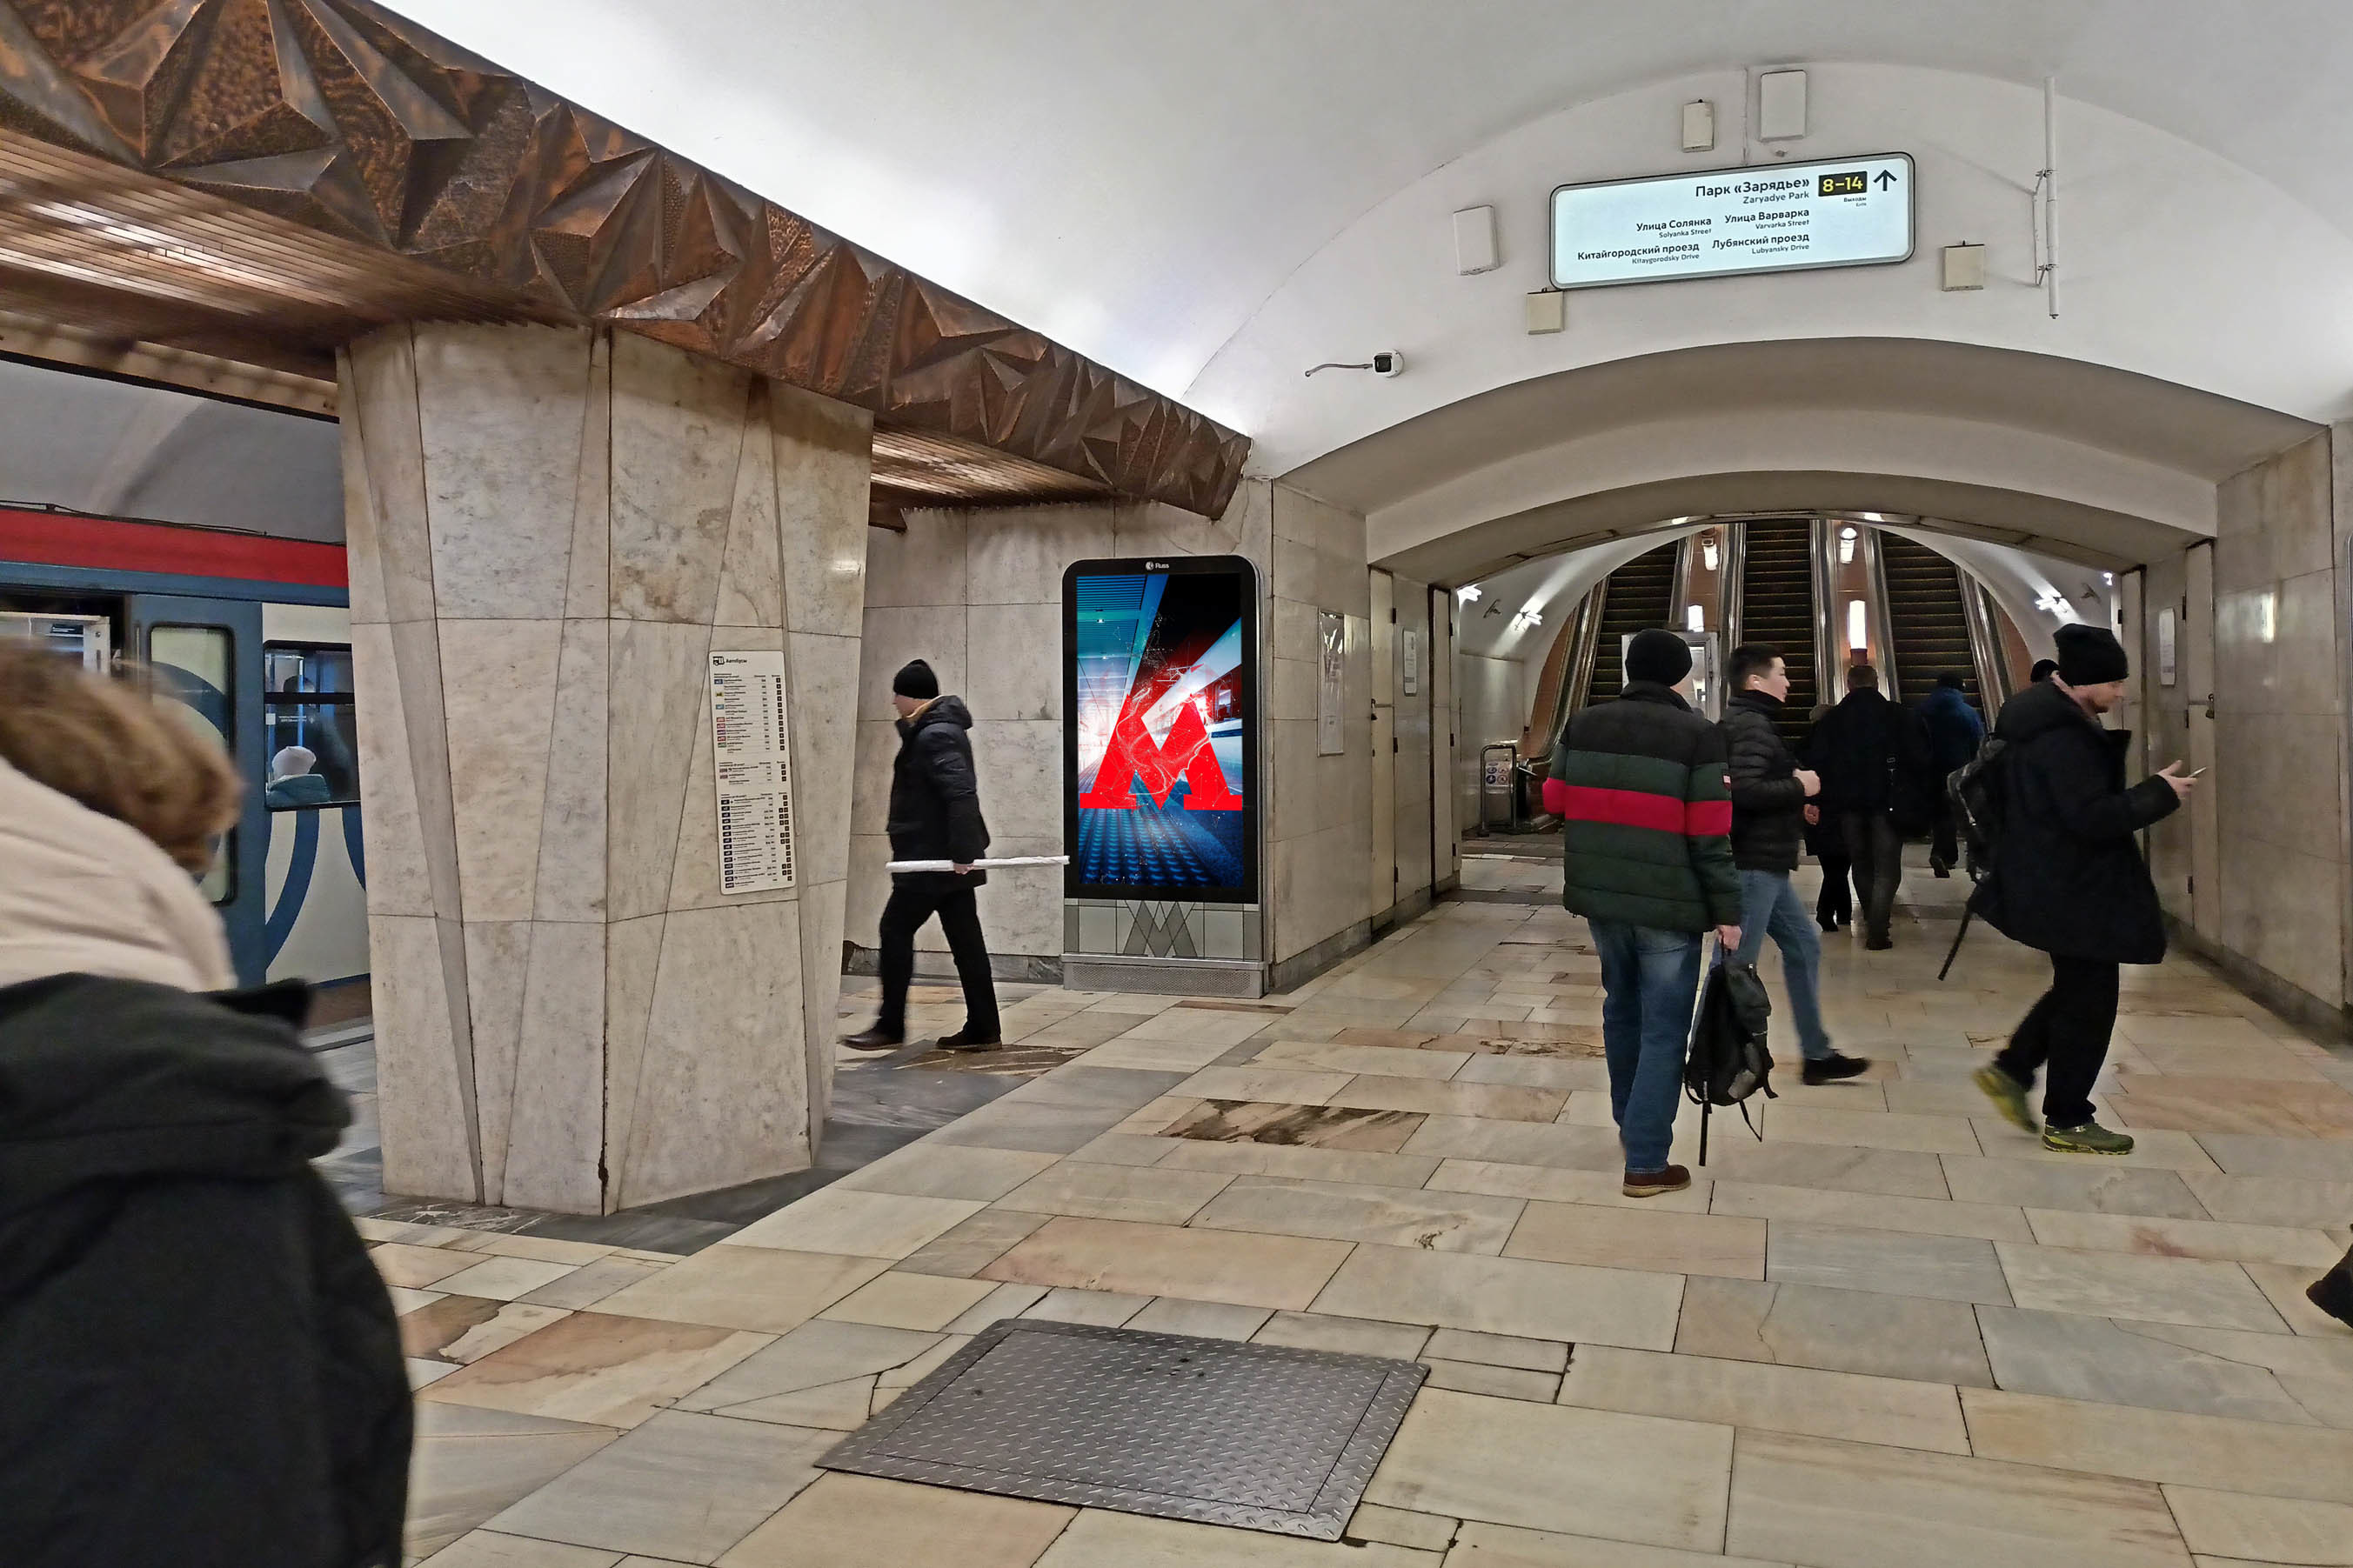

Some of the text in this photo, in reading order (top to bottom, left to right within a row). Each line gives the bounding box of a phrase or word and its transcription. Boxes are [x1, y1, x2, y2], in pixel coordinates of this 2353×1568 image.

[1695, 178, 1810, 197] Парк «Зарядье»
[1742, 191, 1810, 204] Zaryadye Park
[1724, 209, 1810, 224] Улица Варварка
[1636, 217, 1712, 232] Улица Солянка
[1755, 222, 1786, 230] Varvarka
[1659, 230, 1689, 238] Solyanka
[1712, 232, 1810, 250] Лубянский проезд
[1577, 242, 1700, 261] Китайгородский проезд
[1751, 244, 1788, 255] Lubyansky
